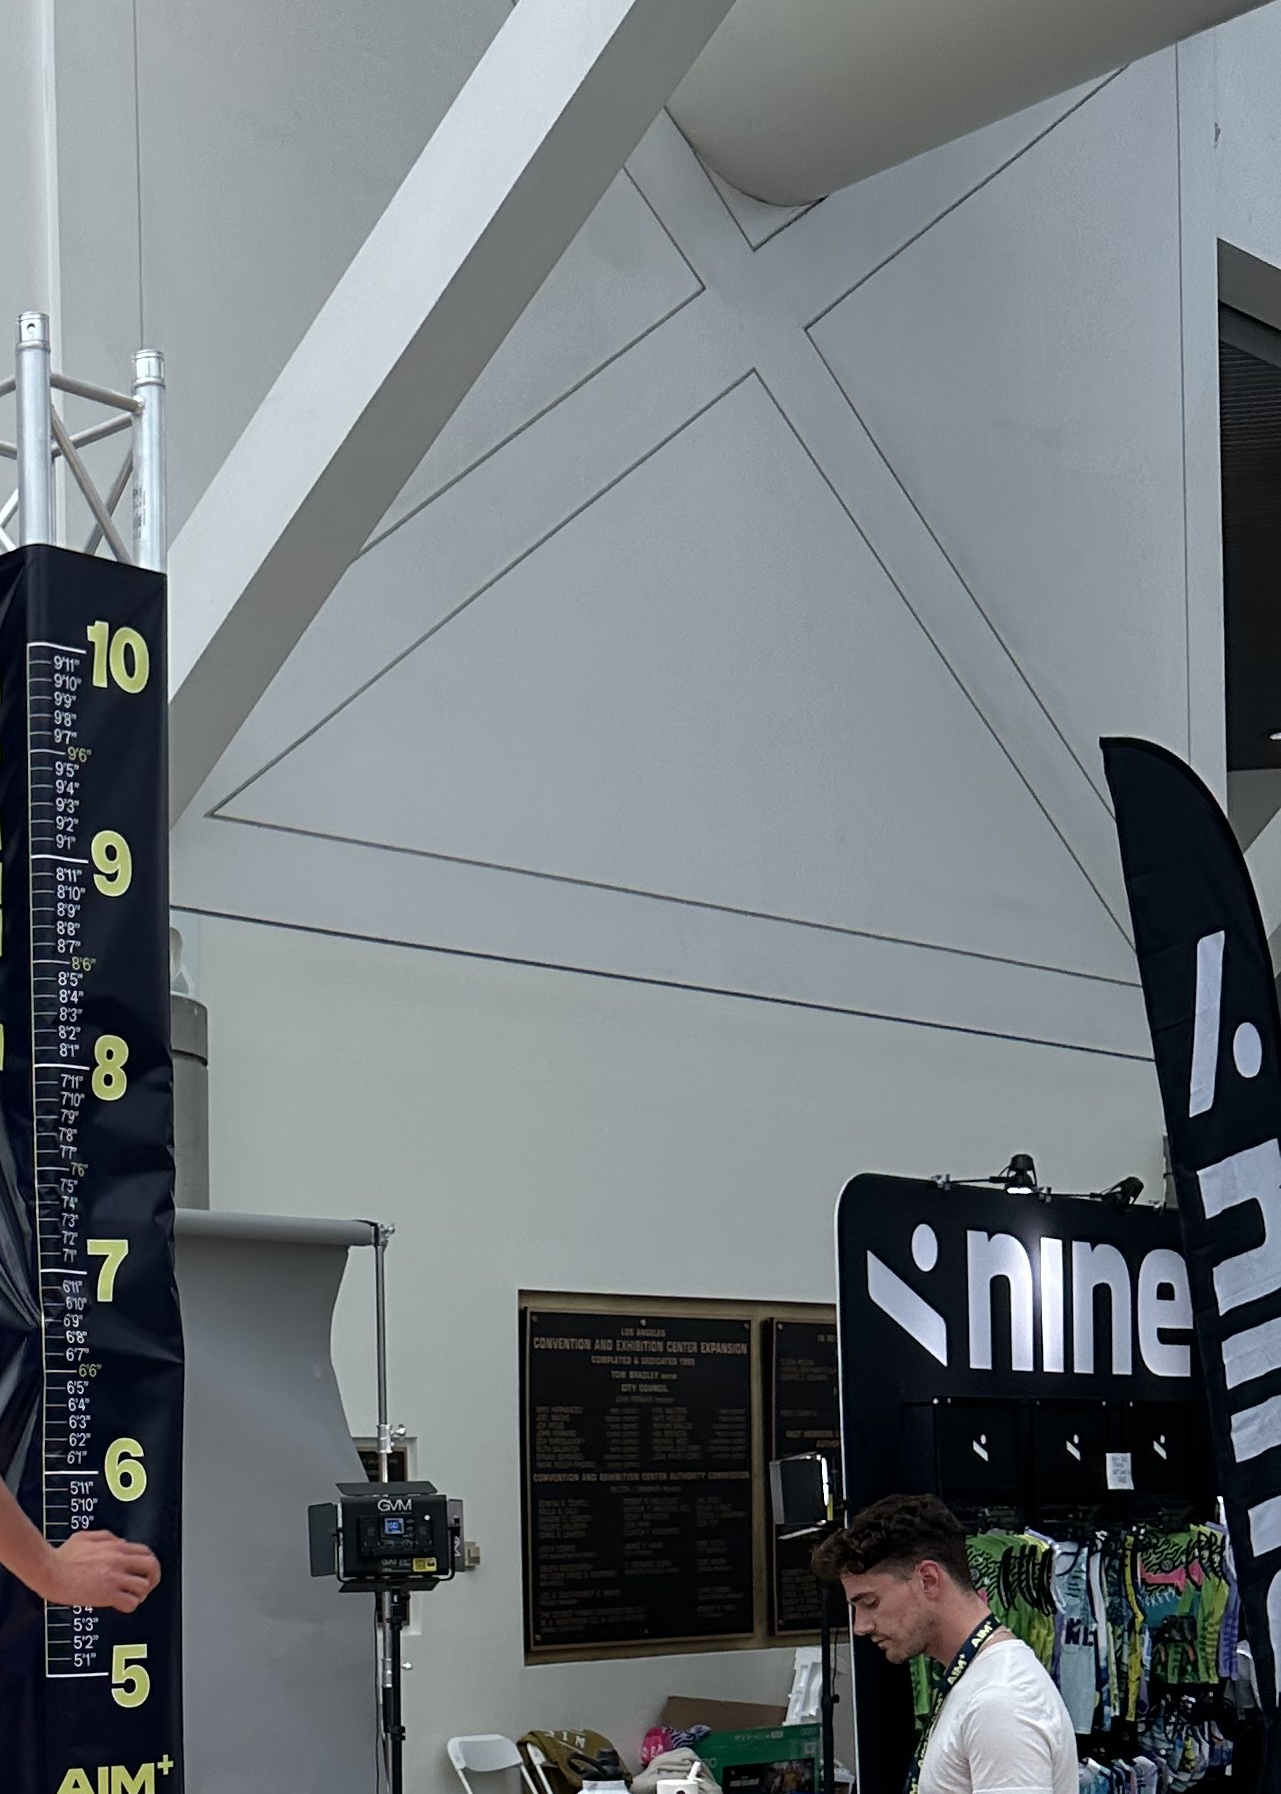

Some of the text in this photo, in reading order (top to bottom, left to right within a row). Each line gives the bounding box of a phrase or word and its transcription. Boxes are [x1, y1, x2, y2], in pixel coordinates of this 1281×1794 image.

[86, 620, 150, 694] 10
[90, 830, 132, 897] 9
[91, 1034, 129, 1101] 8
[87, 1239, 129, 1303] 7
[967, 1229, 1194, 1378] nine
[533, 1337, 748, 1355] CONVENTION AND EXHIBITION CENTER EXPANSION
[105, 1437, 147, 1502] 6
[377, 1498, 413, 1511] GVM
[111, 1643, 150, 1708] 5
